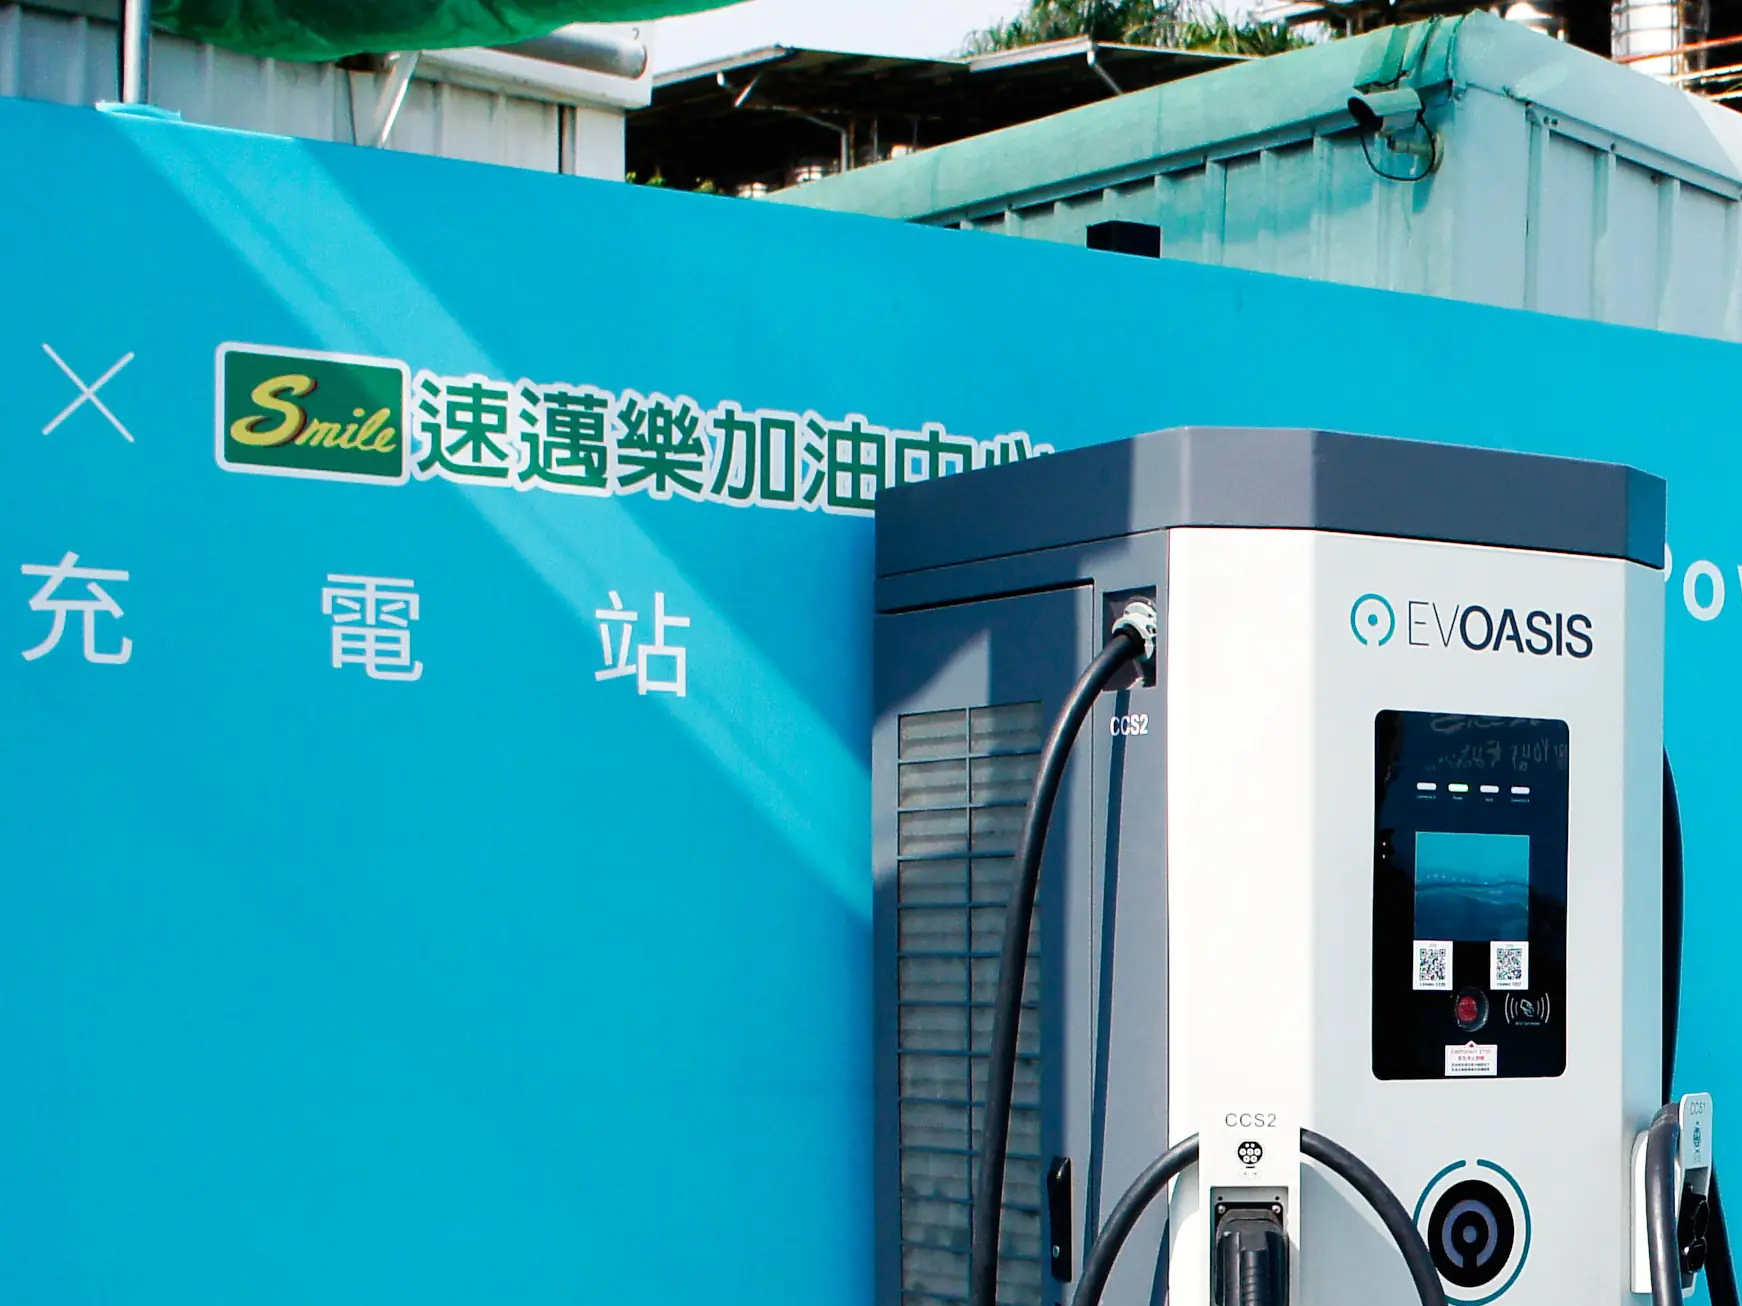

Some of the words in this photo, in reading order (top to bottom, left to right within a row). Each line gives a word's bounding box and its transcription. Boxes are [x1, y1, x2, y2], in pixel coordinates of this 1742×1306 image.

[229, 374, 399, 457] Smile
[19, 550, 693, 698] 充電站
[1407, 599, 1594, 659] EVOASIS
[1109, 714, 1149, 737] CCS2
[1224, 1112, 1277, 1128] CCS2
